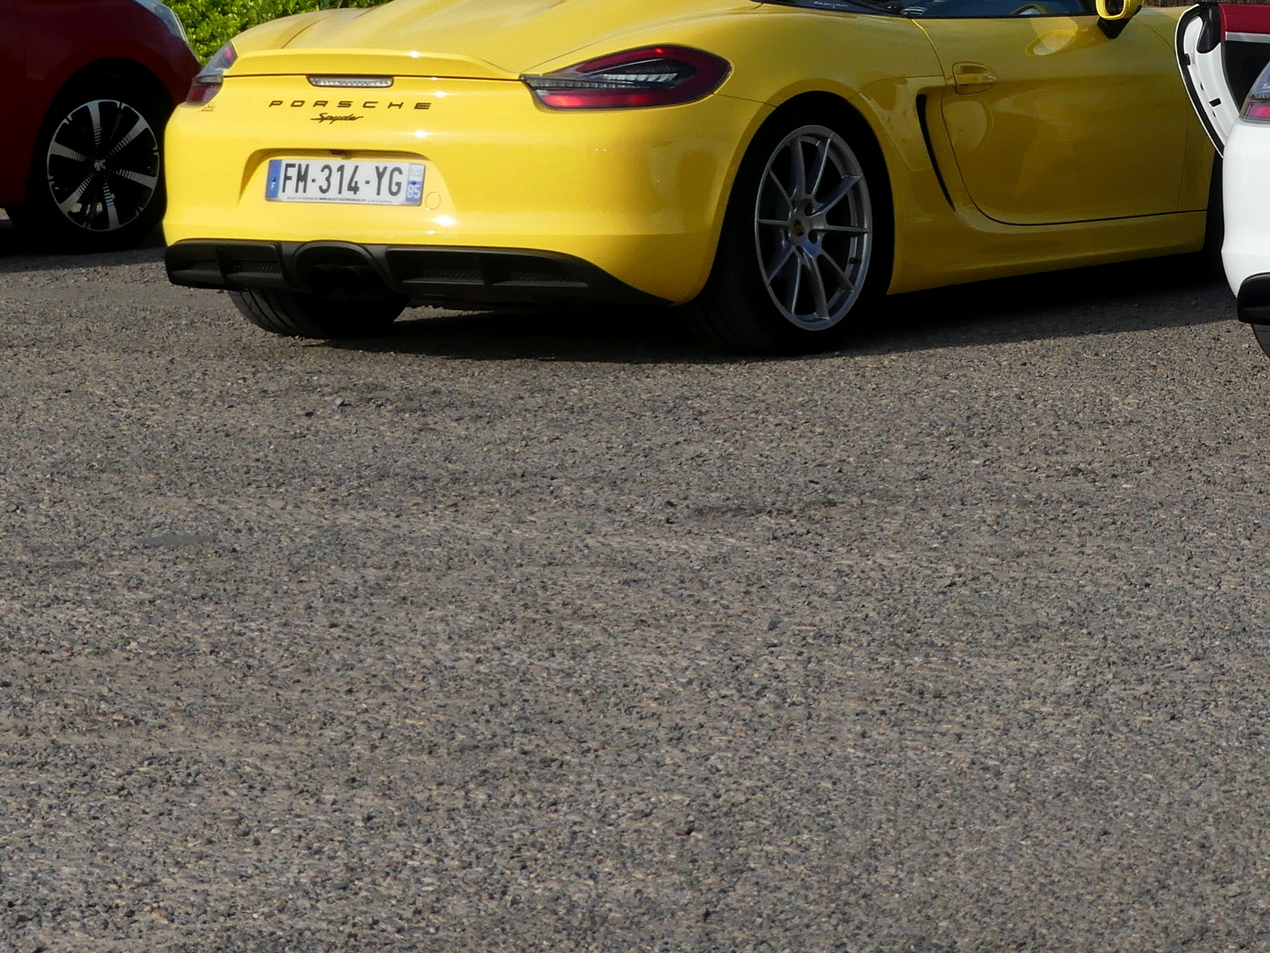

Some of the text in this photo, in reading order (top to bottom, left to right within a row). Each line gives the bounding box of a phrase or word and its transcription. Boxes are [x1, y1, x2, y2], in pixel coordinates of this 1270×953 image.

[268, 100, 432, 110] PORSCHE
[310, 112, 364, 125] Spyder
[282, 163, 403, 197] FM-314-YG
[406, 184, 421, 199] 85
